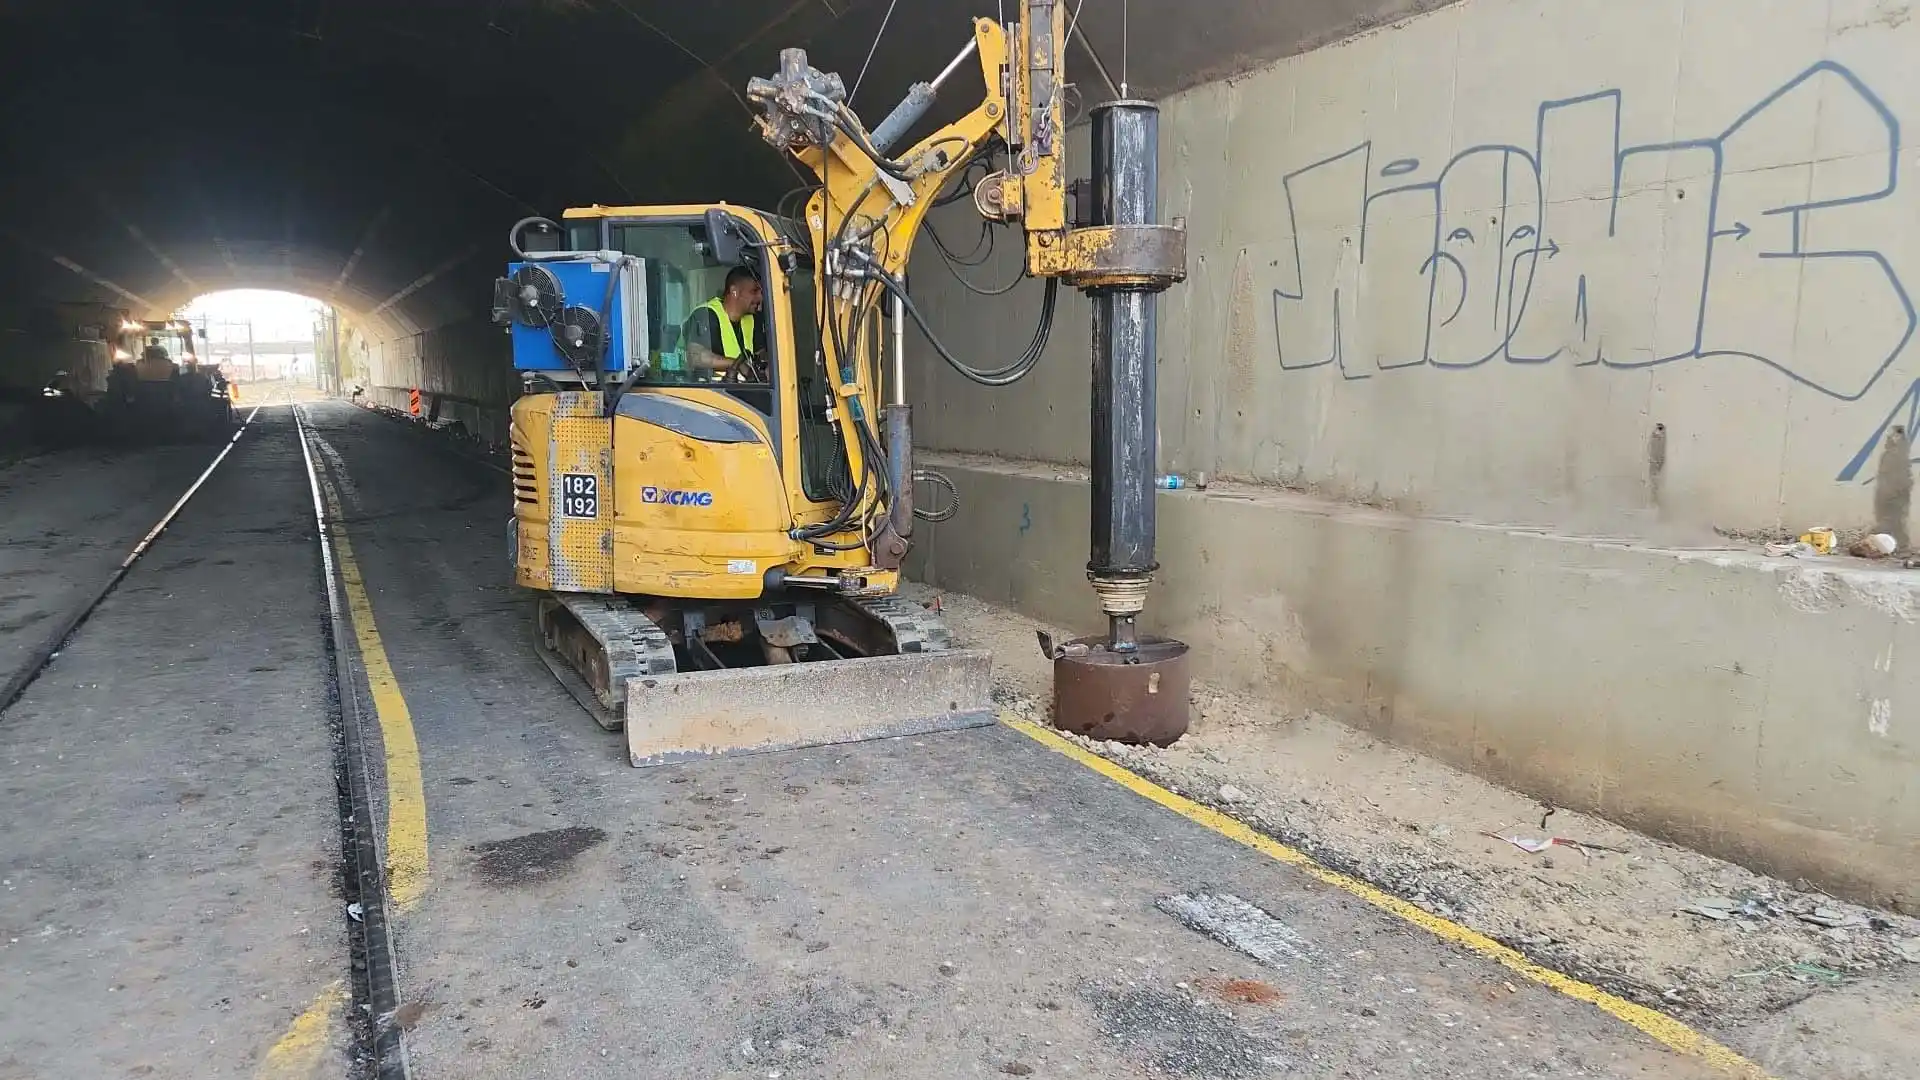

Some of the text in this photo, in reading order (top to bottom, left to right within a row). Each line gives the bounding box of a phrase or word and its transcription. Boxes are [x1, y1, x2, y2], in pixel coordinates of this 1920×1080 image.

[564, 476, 595, 495] 182
[566, 497, 595, 516] 192
[658, 488, 713, 506] XCMG
